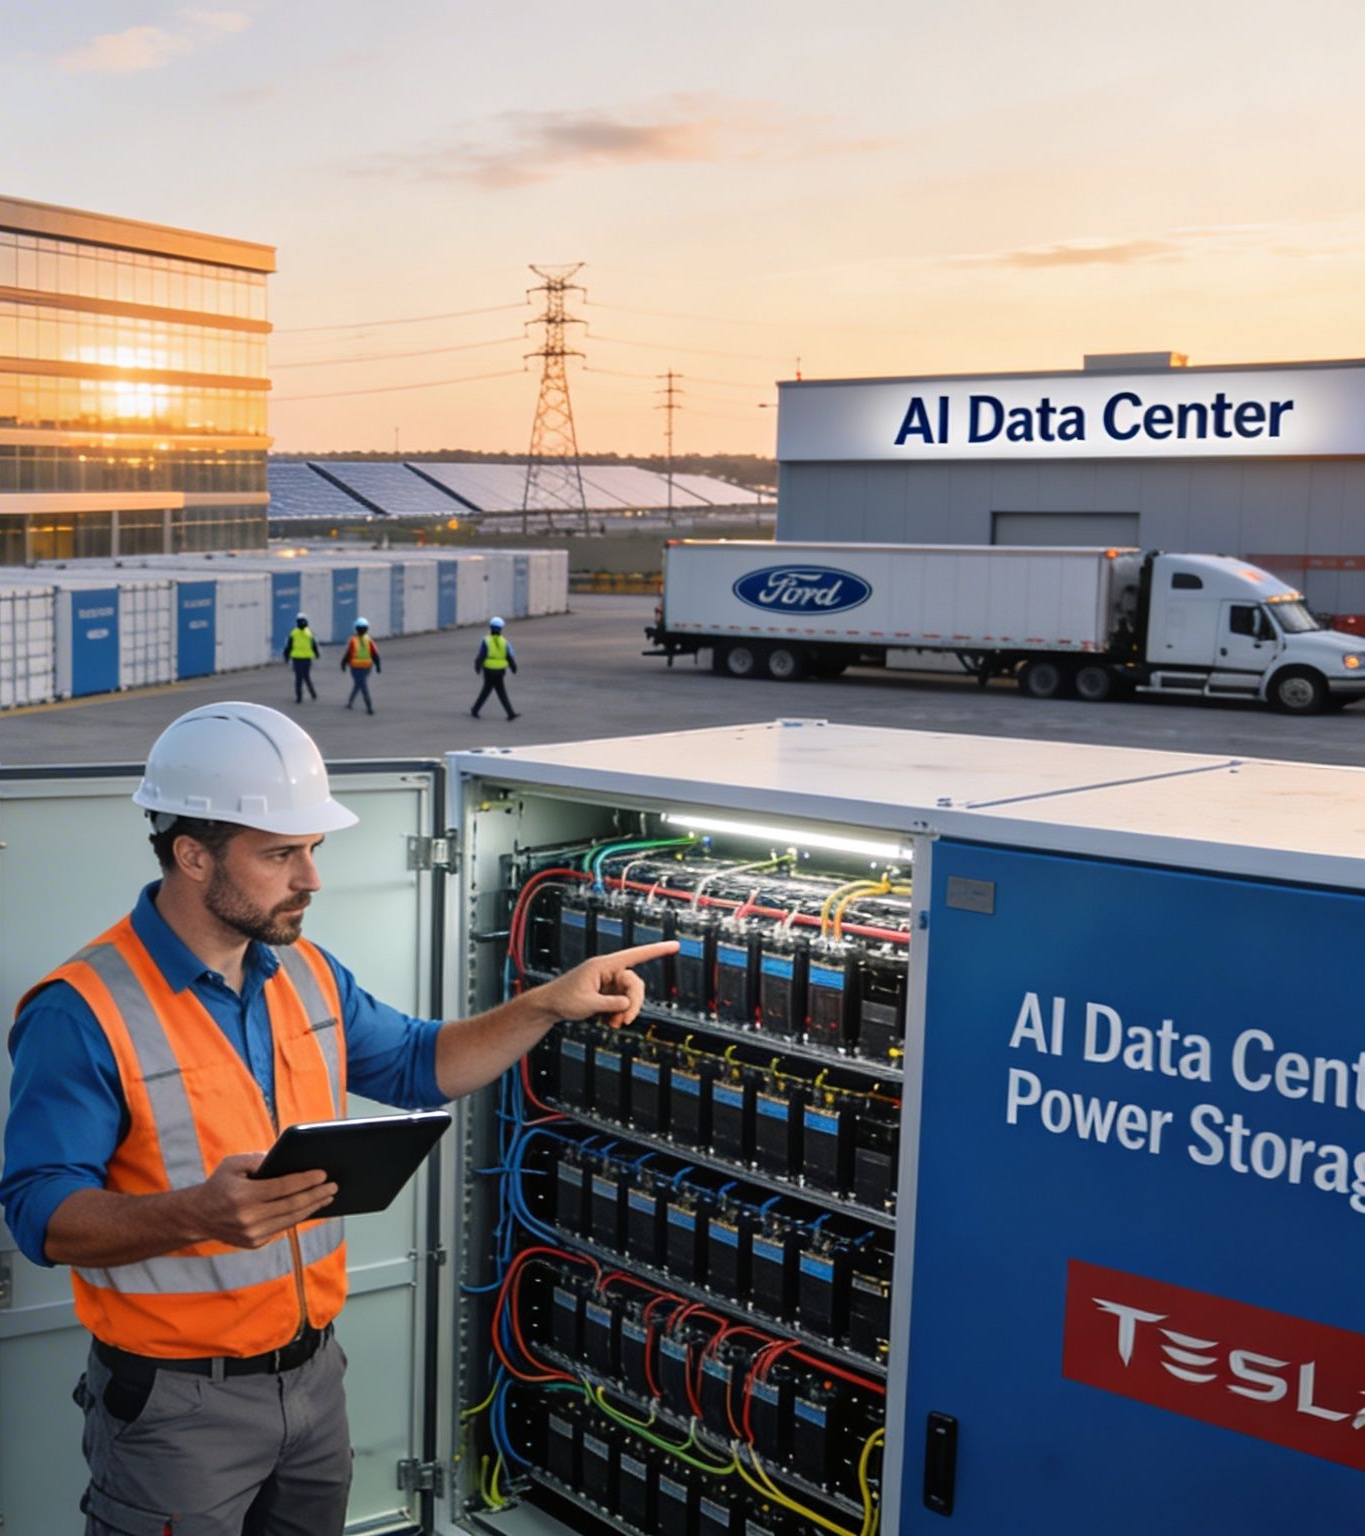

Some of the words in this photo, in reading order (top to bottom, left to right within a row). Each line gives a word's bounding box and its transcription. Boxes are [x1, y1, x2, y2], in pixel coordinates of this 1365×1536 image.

[894, 396, 949, 445] AI
[968, 395, 1085, 444] Data
[1102, 391, 1294, 441] Center
[758, 571, 843, 606] Ford
[1009, 991, 1066, 1056] AI
[1084, 1001, 1212, 1083] Data
[1006, 1067, 1173, 1155] Power
